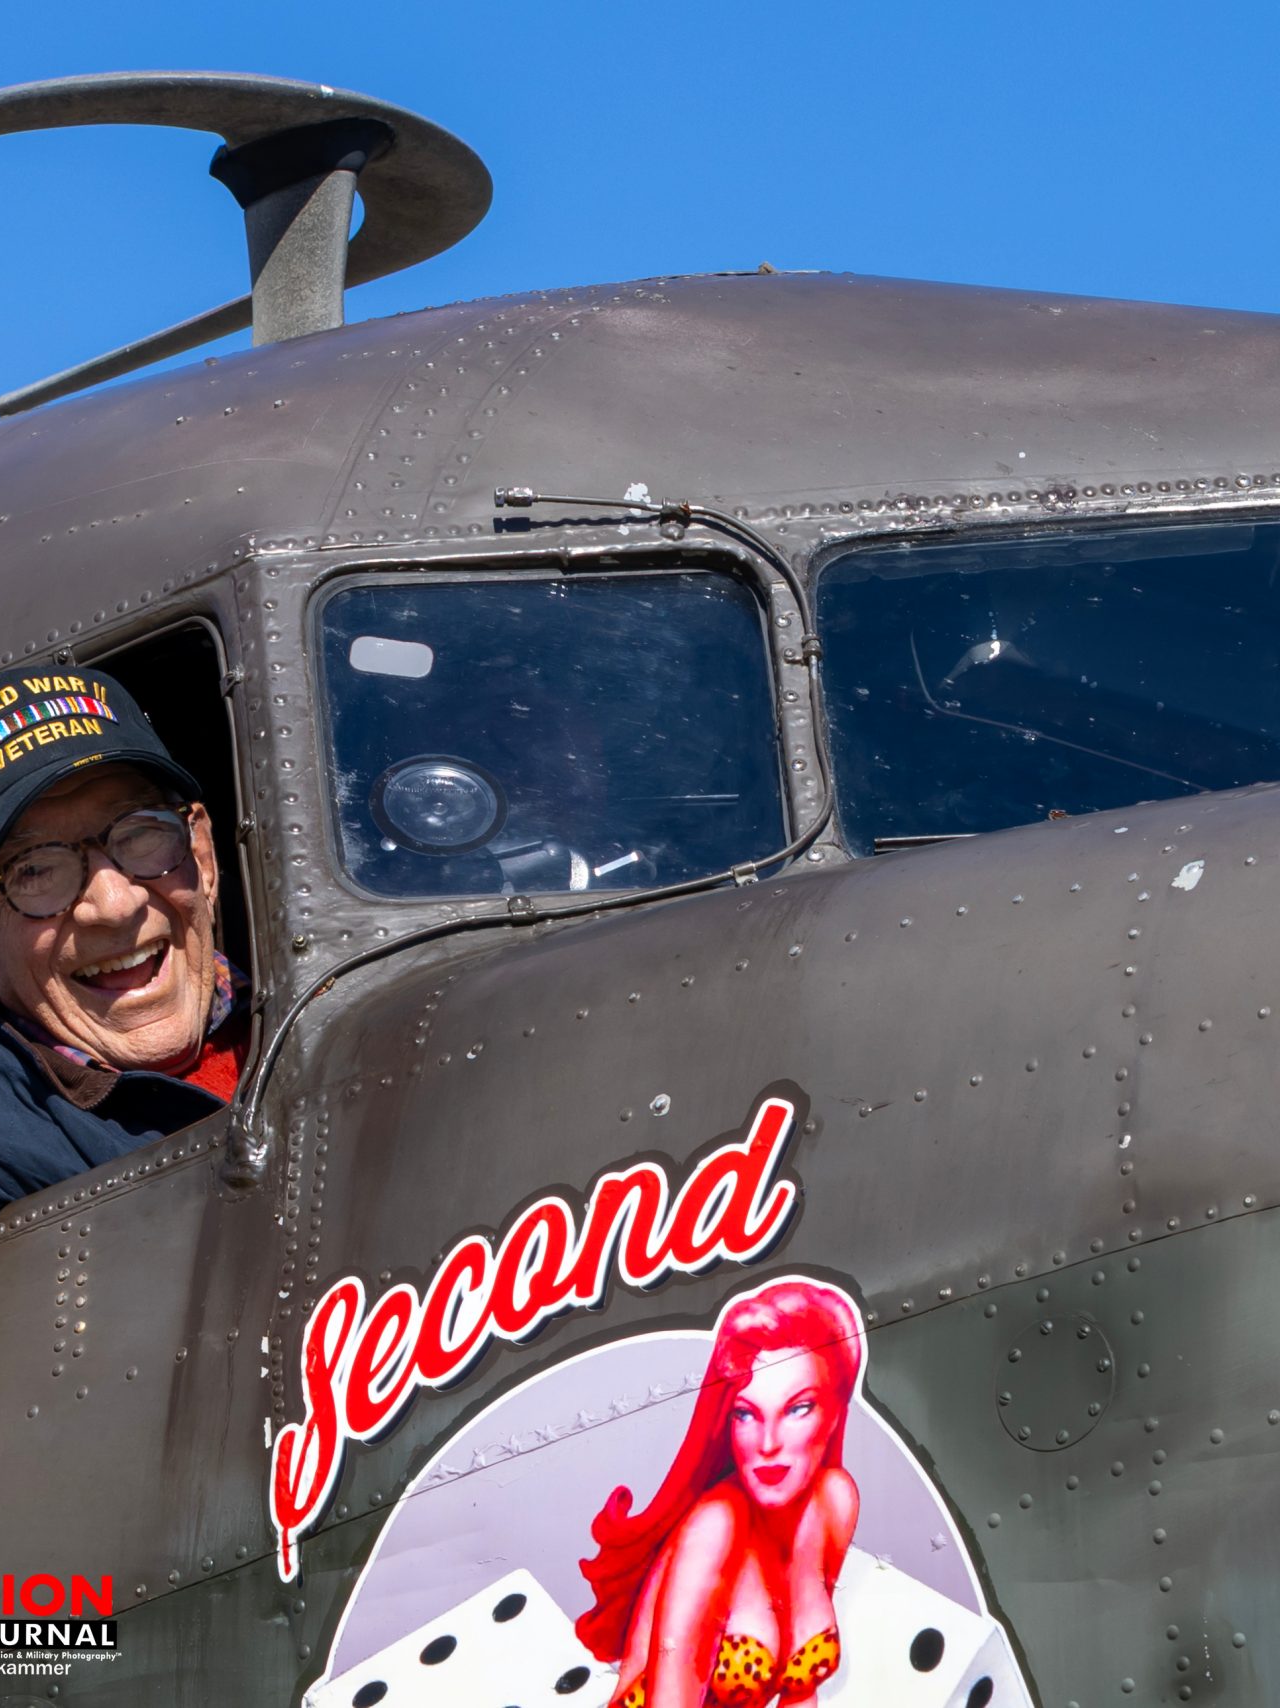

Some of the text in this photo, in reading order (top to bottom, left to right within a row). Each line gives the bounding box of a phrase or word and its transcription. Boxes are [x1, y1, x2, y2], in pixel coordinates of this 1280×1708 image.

[22, 676, 88, 695] WAR
[92, 681, 107, 703] II
[271, 1099, 794, 1582] Second
